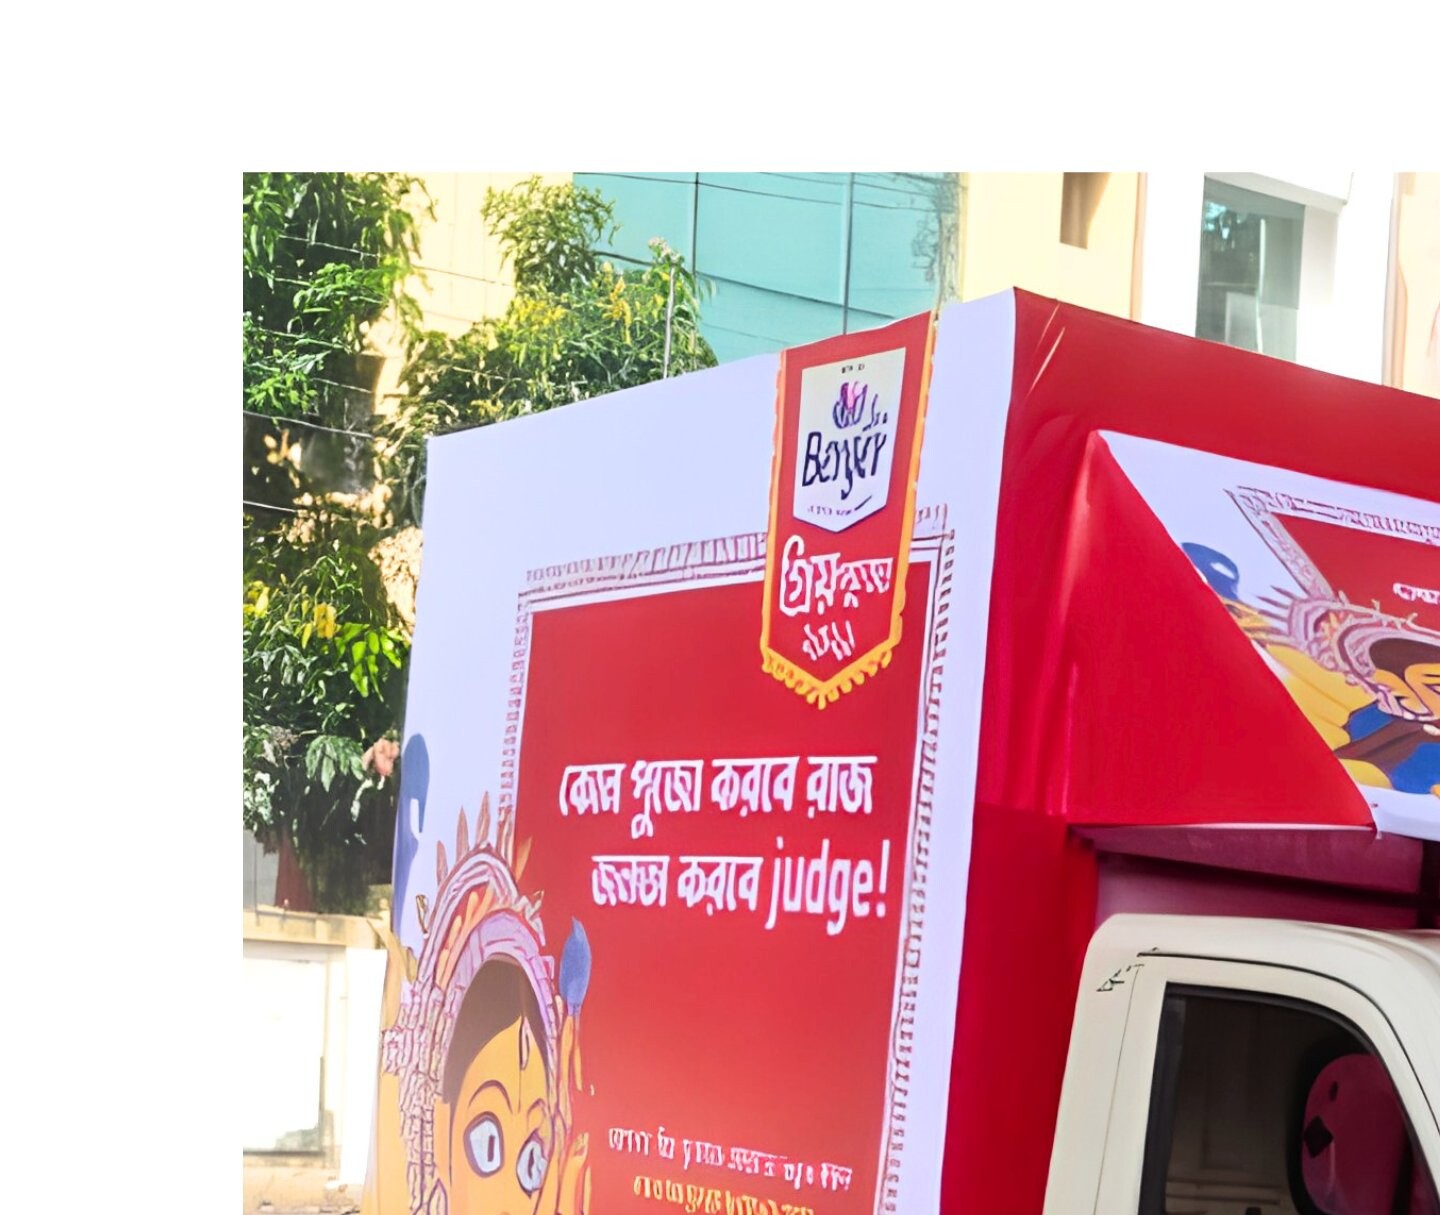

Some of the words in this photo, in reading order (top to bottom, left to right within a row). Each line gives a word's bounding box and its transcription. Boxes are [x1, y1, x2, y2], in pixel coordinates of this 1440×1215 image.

[711, 756, 800, 818] করবে
[807, 756, 879, 819] রাজ
[764, 836, 891, 936] judge!
